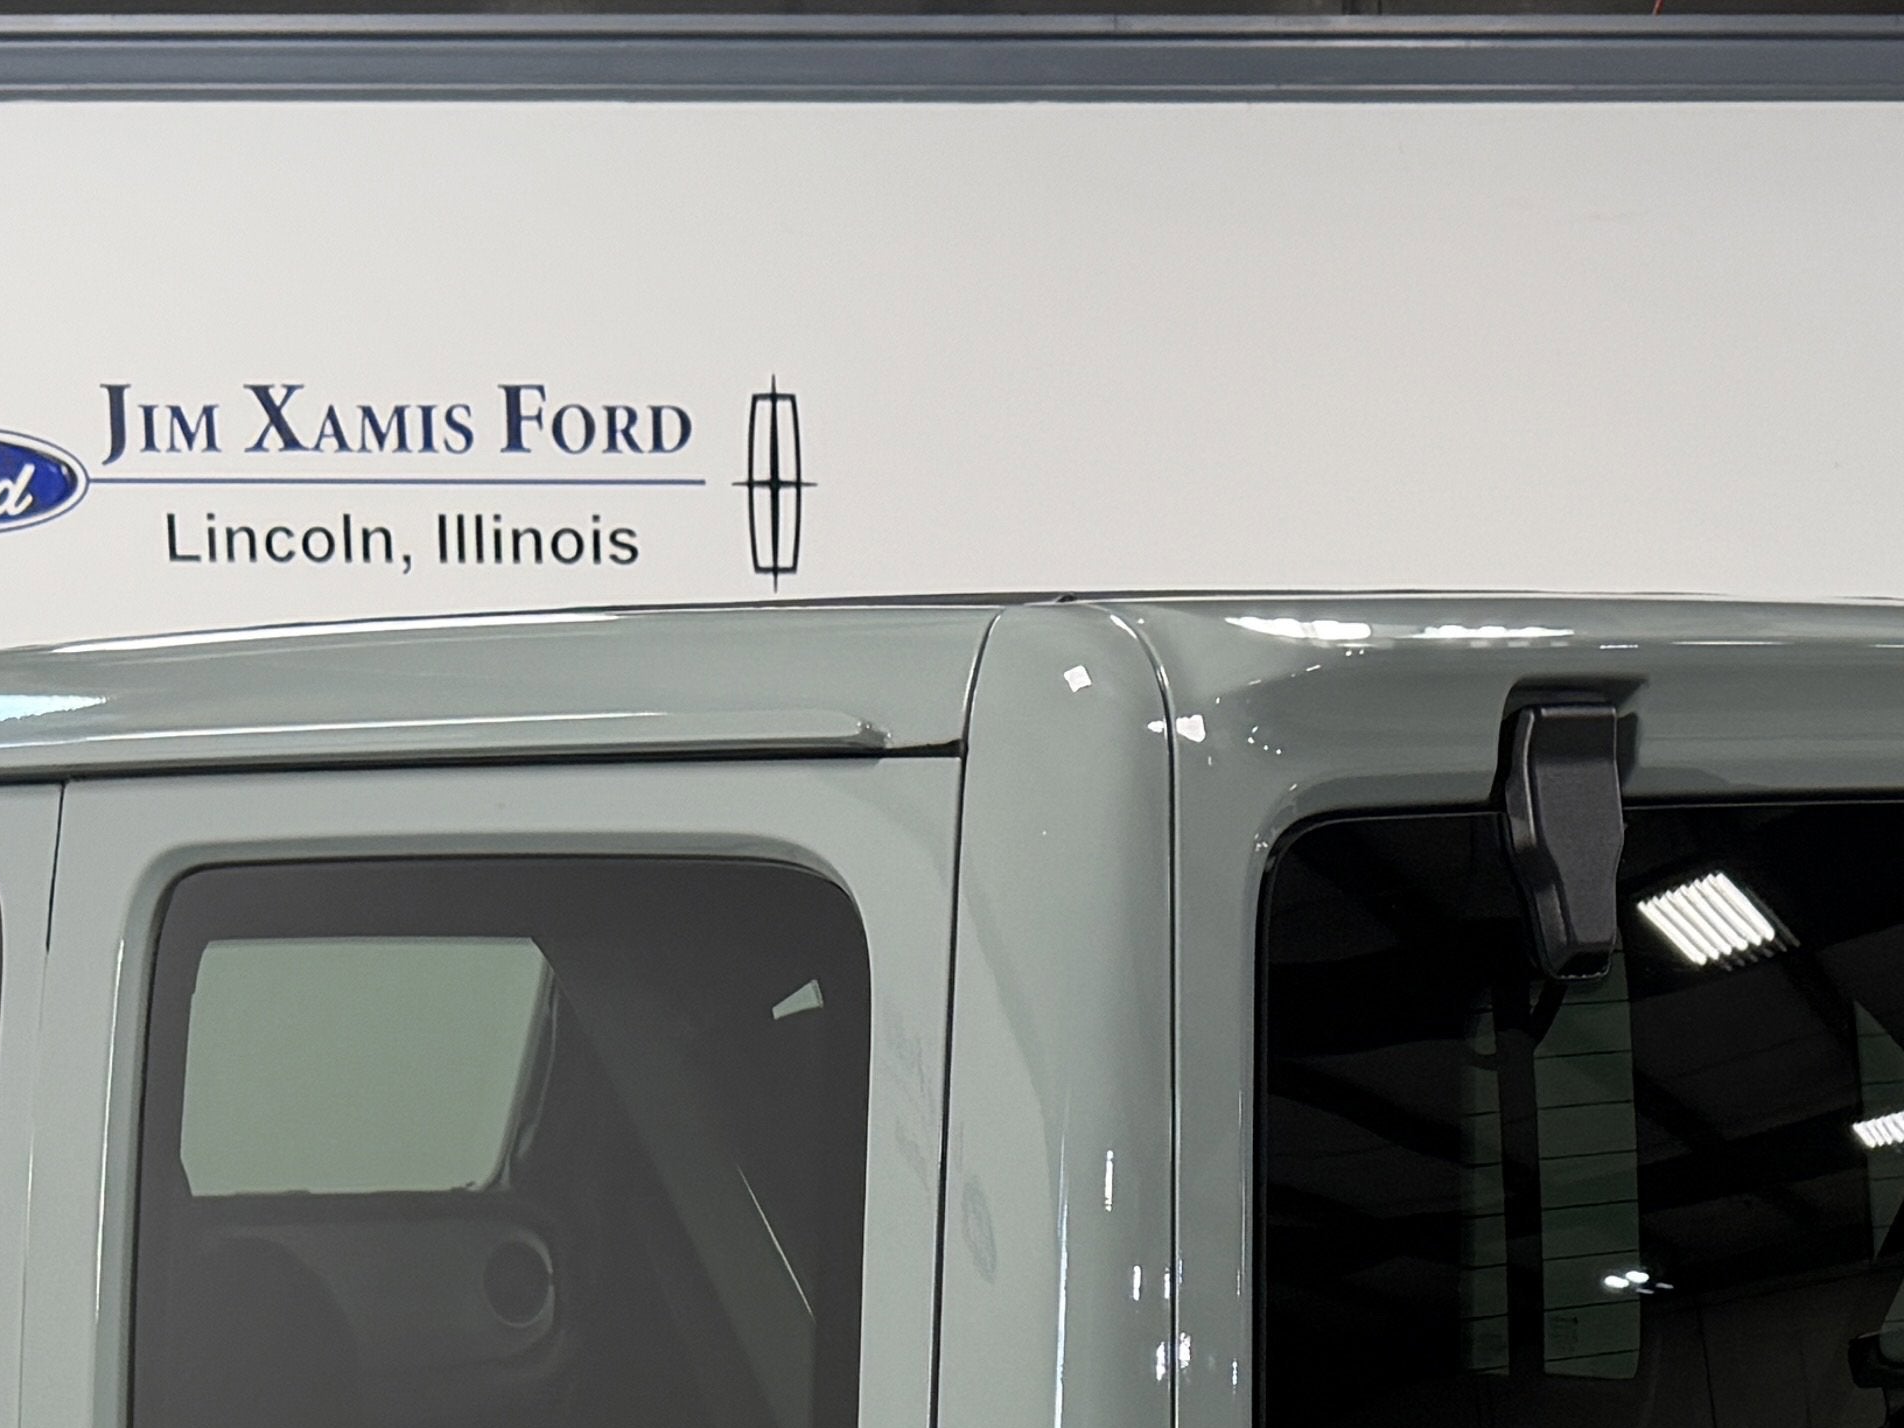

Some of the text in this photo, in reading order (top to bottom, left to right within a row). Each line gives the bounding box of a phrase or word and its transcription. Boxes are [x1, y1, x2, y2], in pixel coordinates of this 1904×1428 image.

[100, 384, 692, 466] JIM XAMIS FORD
[166, 512, 639, 575] Lincoln, Illinois
